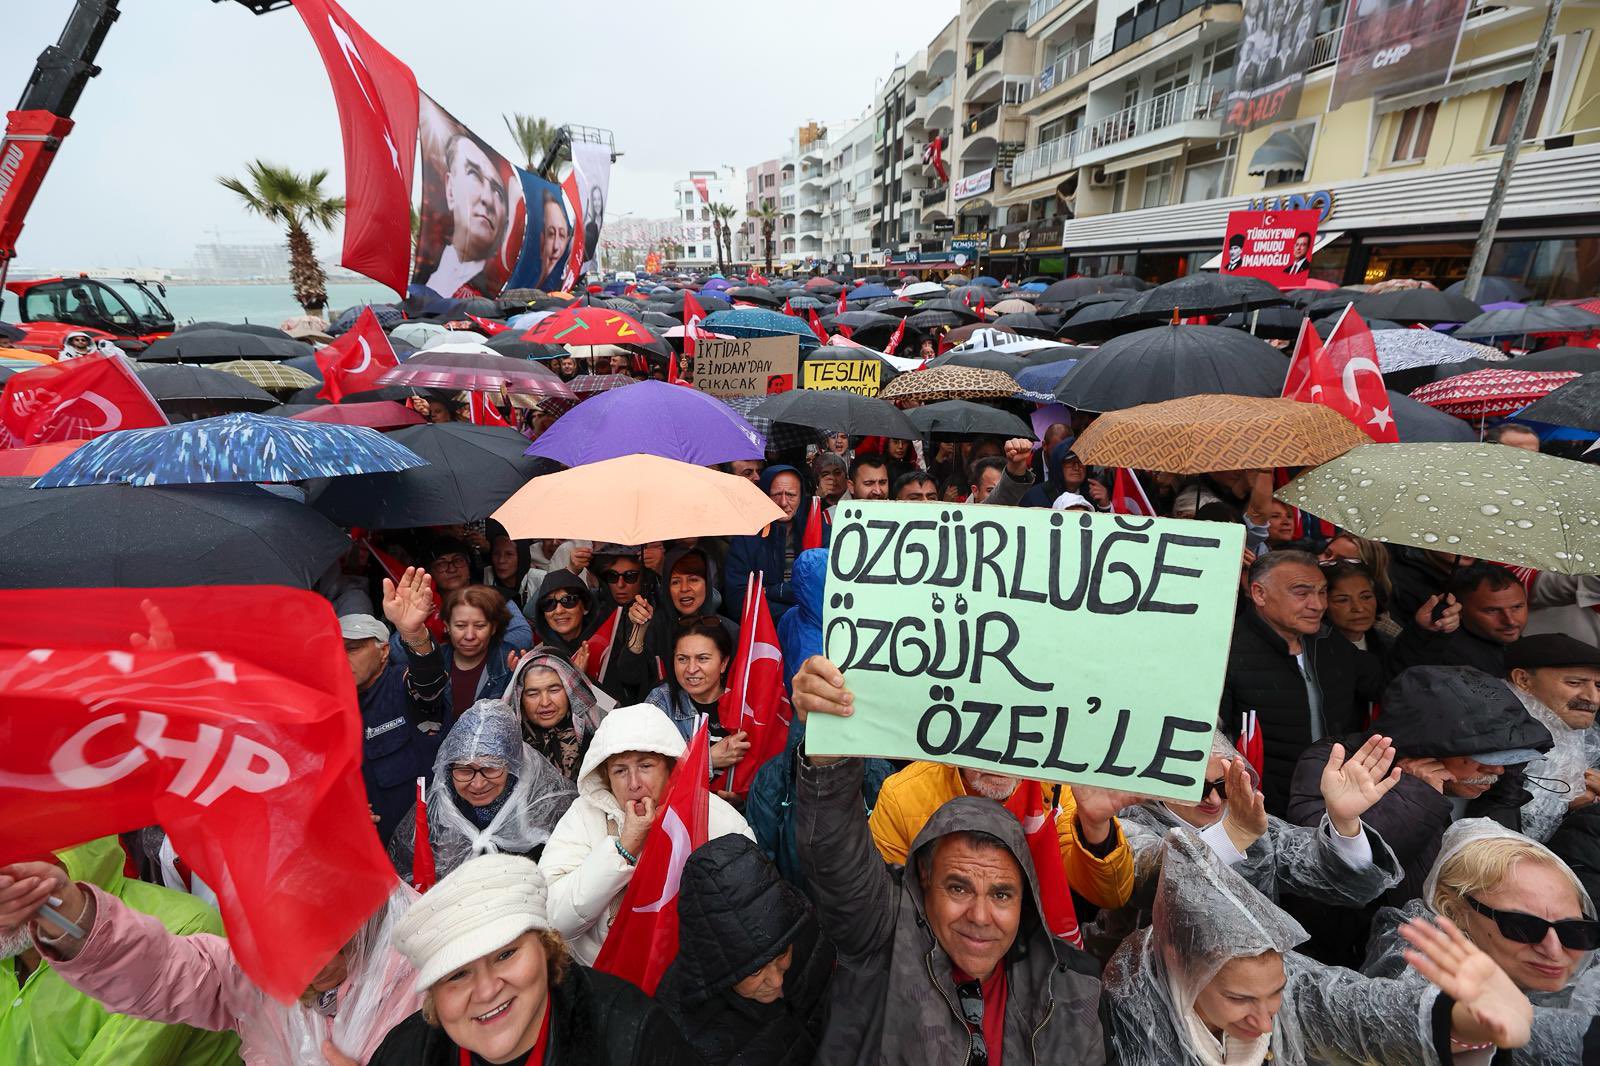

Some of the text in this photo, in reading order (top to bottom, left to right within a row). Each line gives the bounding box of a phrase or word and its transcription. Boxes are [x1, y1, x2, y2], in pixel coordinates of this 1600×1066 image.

[1372, 43, 1412, 69] CHP
[1253, 240, 1286, 253] UMUDU
[1241, 251, 1291, 267] İMAMOĞLU
[698, 340, 752, 359] İKTİDAR
[697, 360, 772, 375] ZİNDAN'DAN
[809, 360, 877, 382] TESLİM
[698, 377, 758, 391] ÇIKACAK
[830, 508, 1221, 615] ÖZGÜRLÜĞE
[825, 593, 1055, 692] ÖZGÜR
[916, 684, 1213, 787] ÖZEL'LE
[50, 710, 291, 807] CHP
